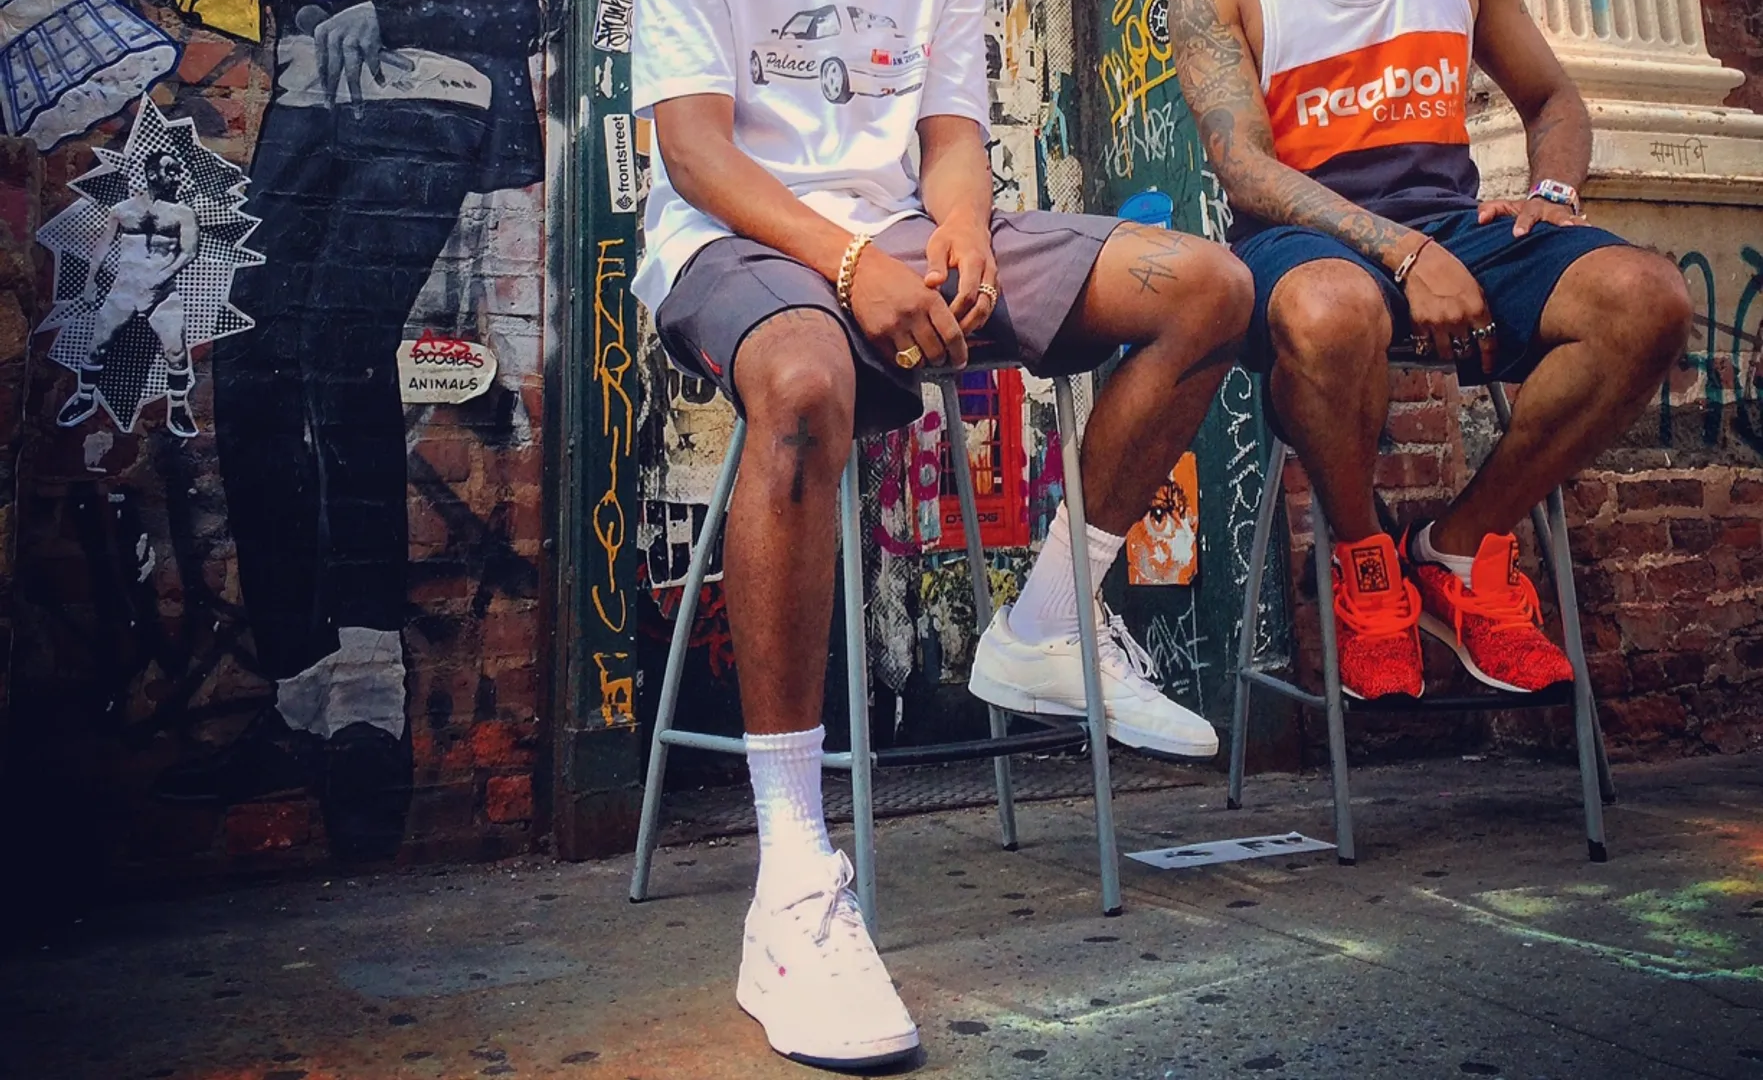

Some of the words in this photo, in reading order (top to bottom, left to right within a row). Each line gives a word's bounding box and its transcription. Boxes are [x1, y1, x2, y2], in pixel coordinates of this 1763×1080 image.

[766, 51, 817, 72] Palace
[1296, 57, 1459, 127] Reebok
[613, 116, 630, 192] frontstreet
[409, 377, 478, 390] ANIMALS
